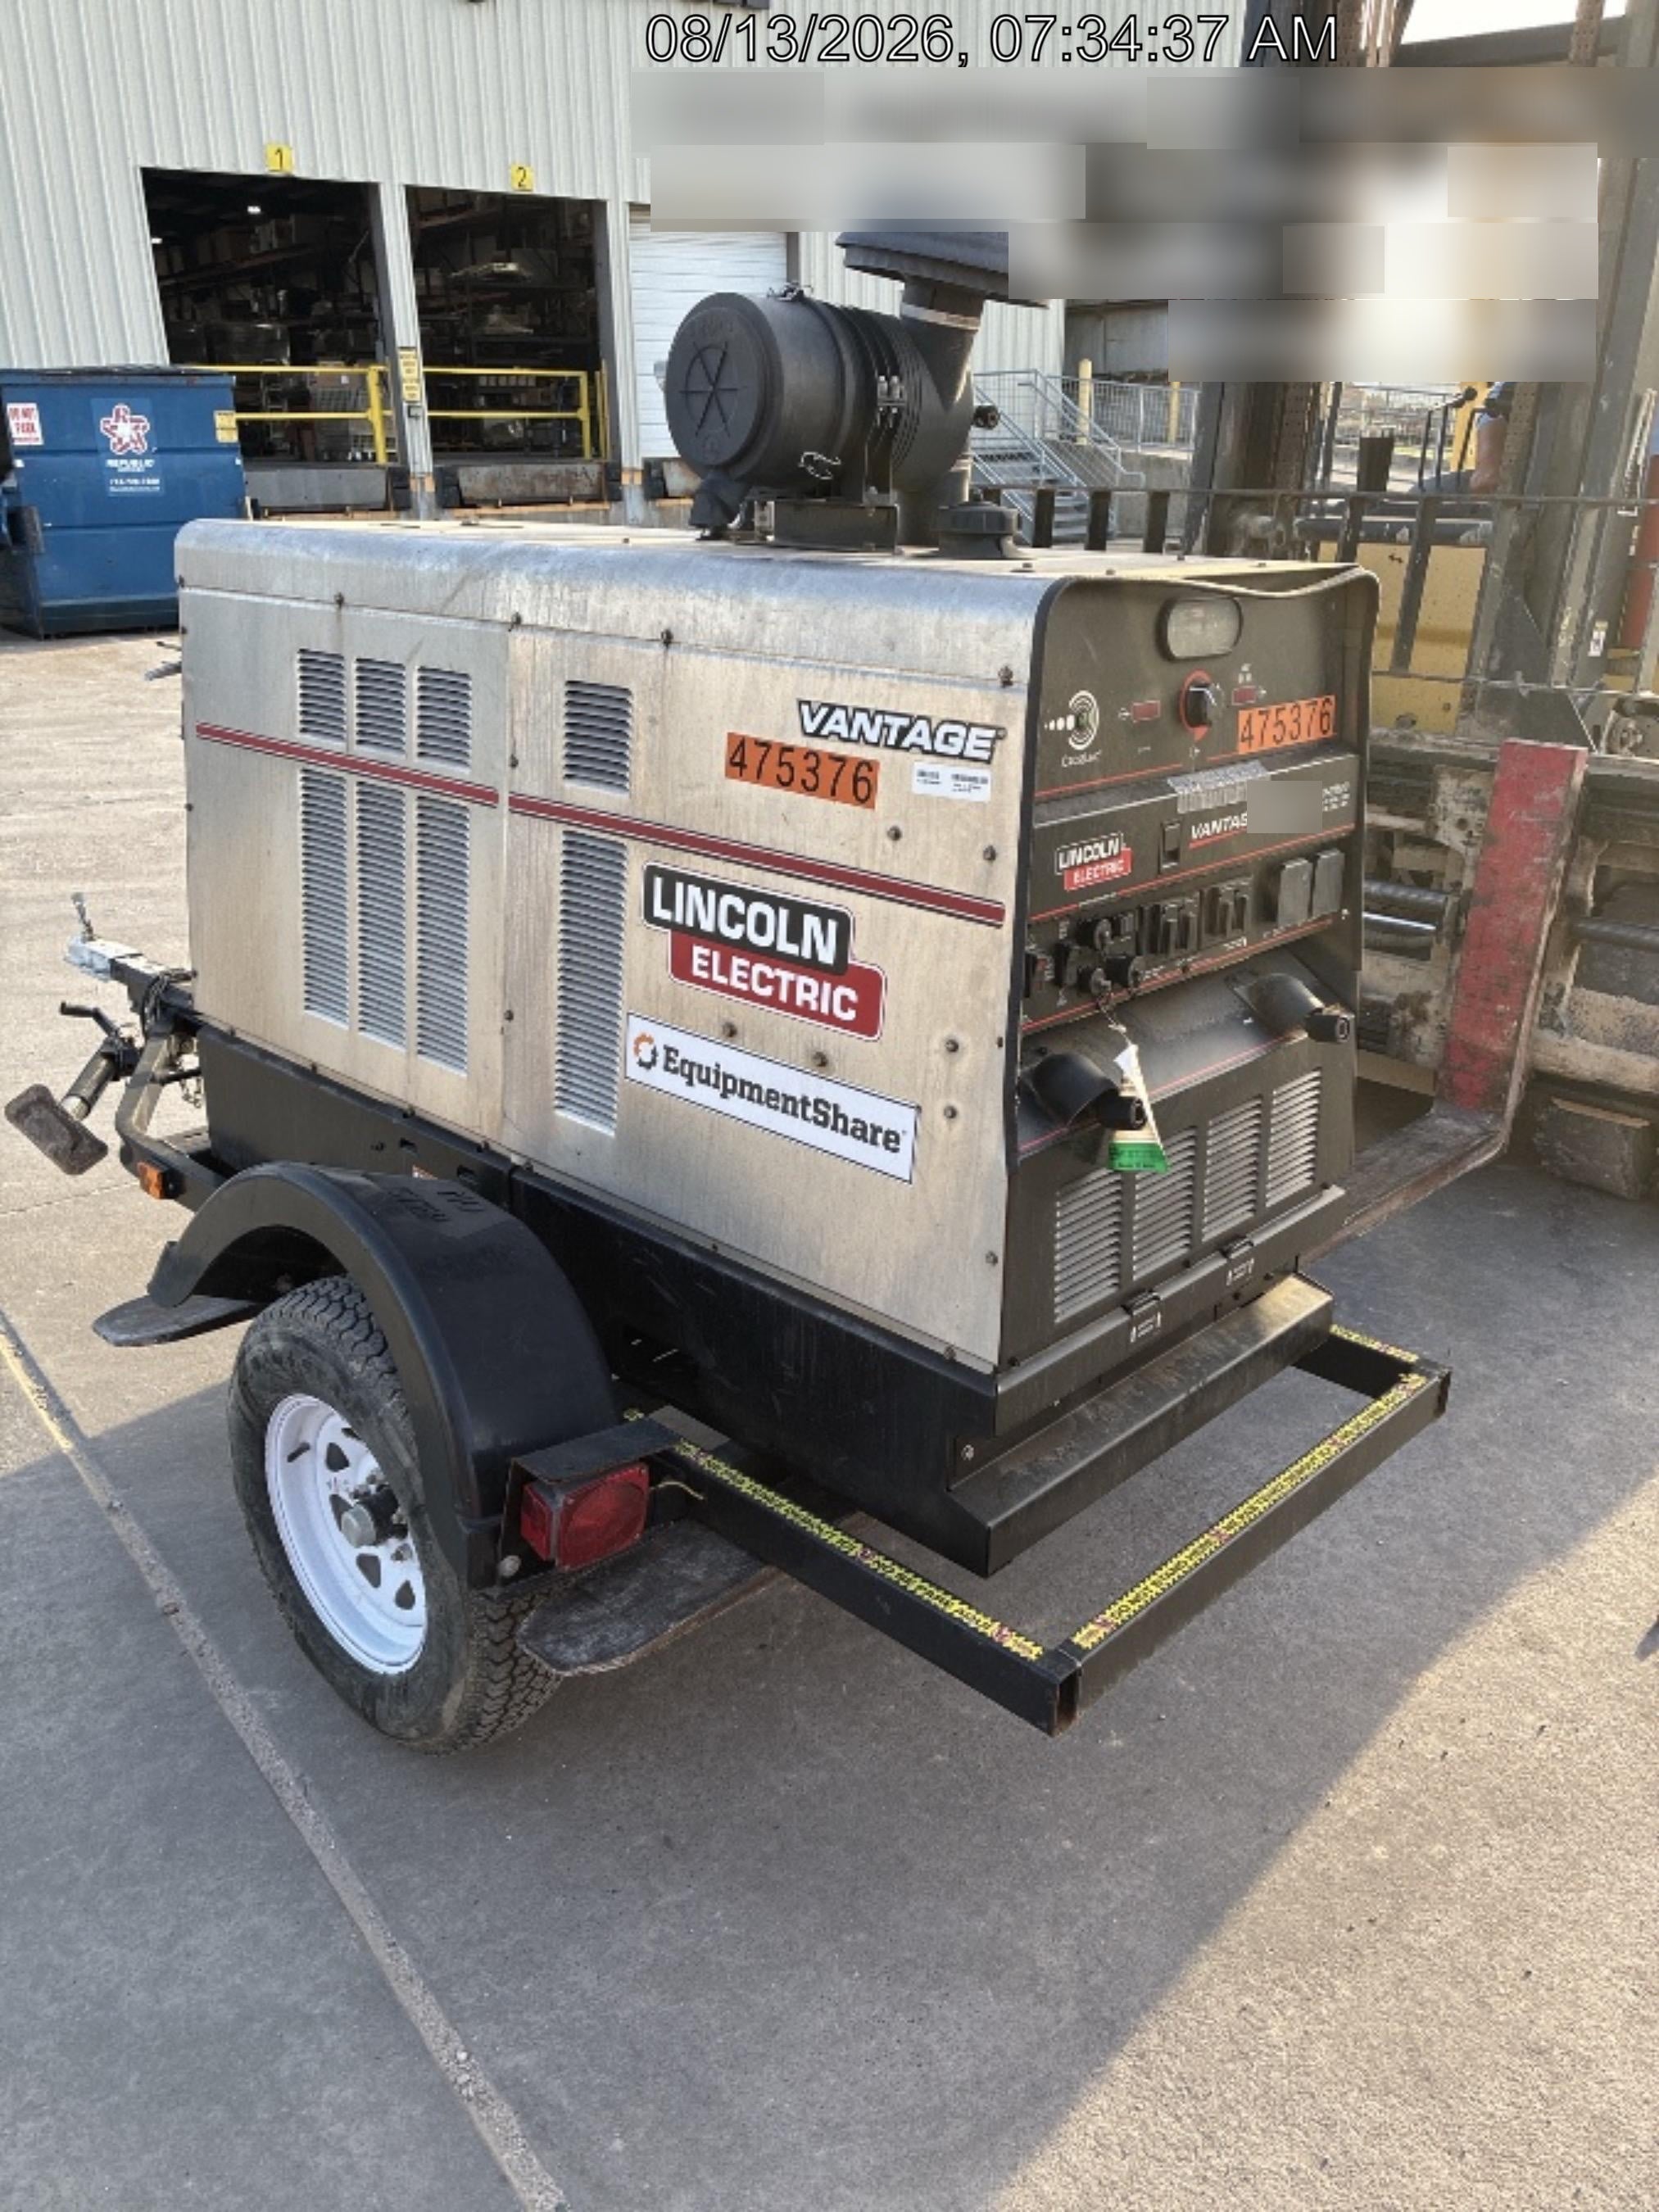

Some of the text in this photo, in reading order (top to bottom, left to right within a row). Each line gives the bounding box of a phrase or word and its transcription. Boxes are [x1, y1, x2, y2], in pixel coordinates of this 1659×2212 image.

[274, 147, 284, 171] 1
[517, 166, 527, 188] 2
[799, 700, 998, 761] VANTAGE
[1240, 697, 1333, 750] 475376
[728, 737, 873, 805] 475376
[1058, 836, 1120, 869] LINCOLN
[1191, 813, 1248, 840] VANTAG
[1073, 859, 1125, 885] ELECTRIC
[652, 875, 838, 966] LINCOLN
[691, 944, 859, 1022] ELECTRIC
[663, 1045, 901, 1153] EquipmentShare
